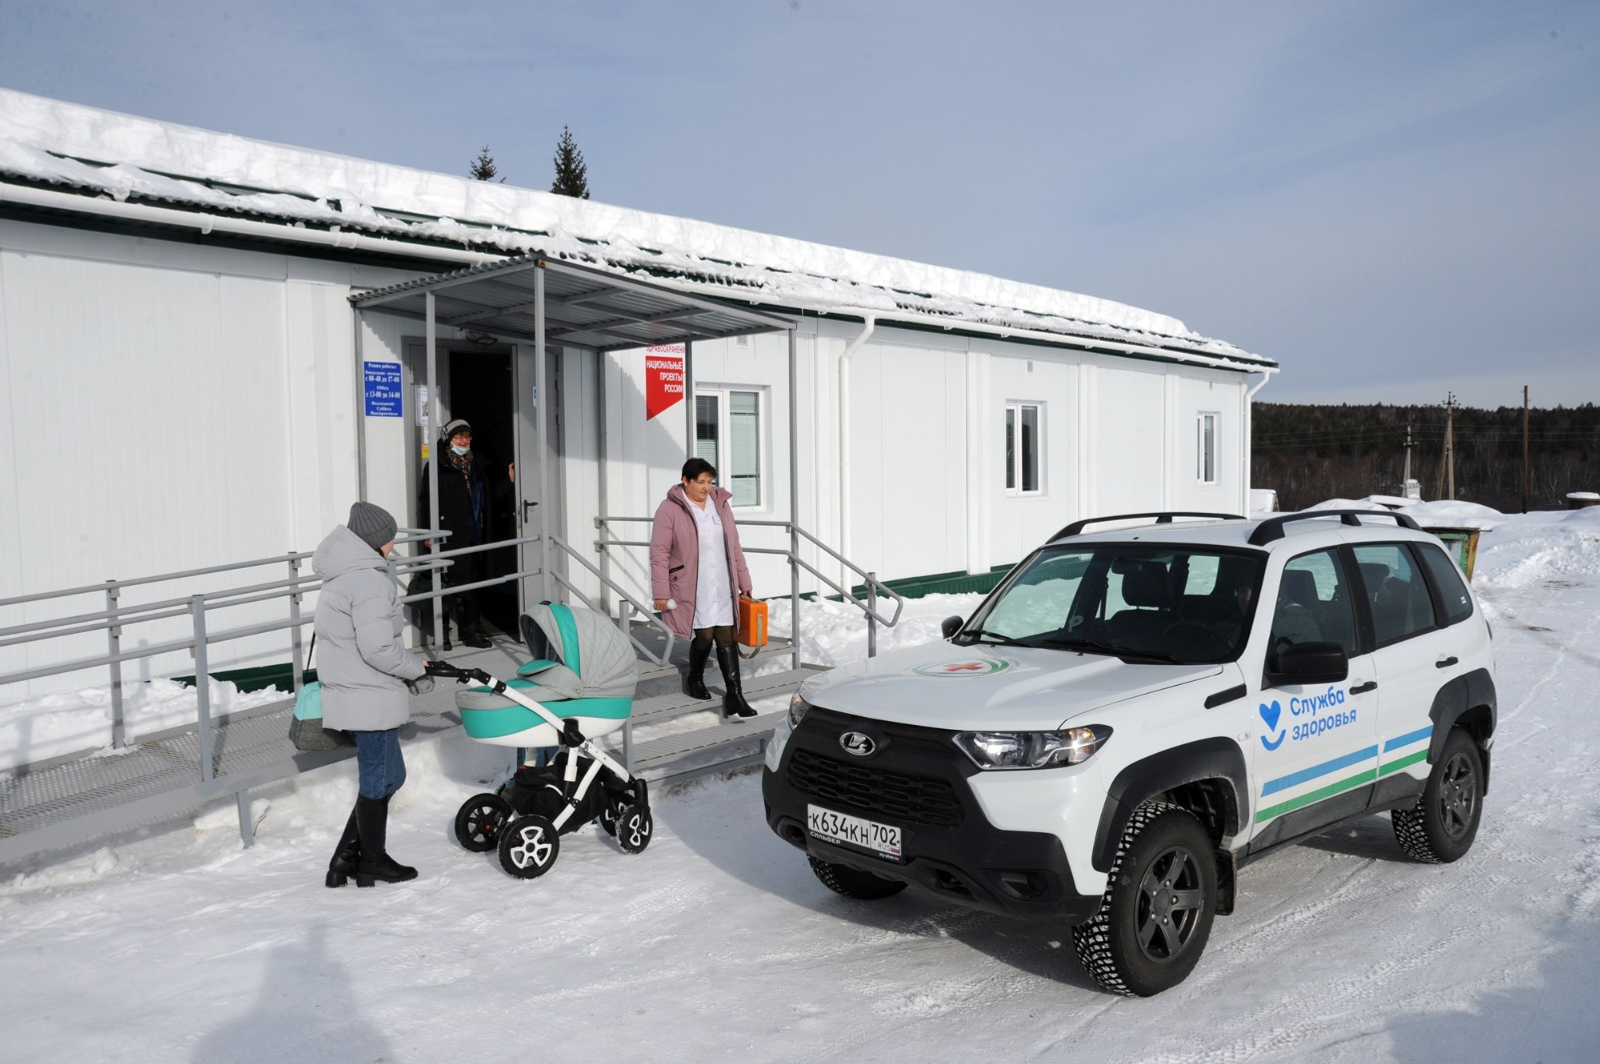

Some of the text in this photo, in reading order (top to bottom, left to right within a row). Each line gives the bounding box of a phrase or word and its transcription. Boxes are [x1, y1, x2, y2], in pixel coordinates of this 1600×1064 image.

[646, 345, 685, 353] ЗДРАВООХРАНЕНИ
[646, 360, 683, 370] НАЦИОНАЛЬНЫЕ
[660, 372, 683, 381] ПРОЕКТЫ
[664, 384, 683, 393] РОССИИ
[388, 391, 401, 399] 14-00
[1290, 686, 1345, 717] Служба
[1292, 708, 1357, 741] здоровья
[877, 842, 891, 852] RUS
